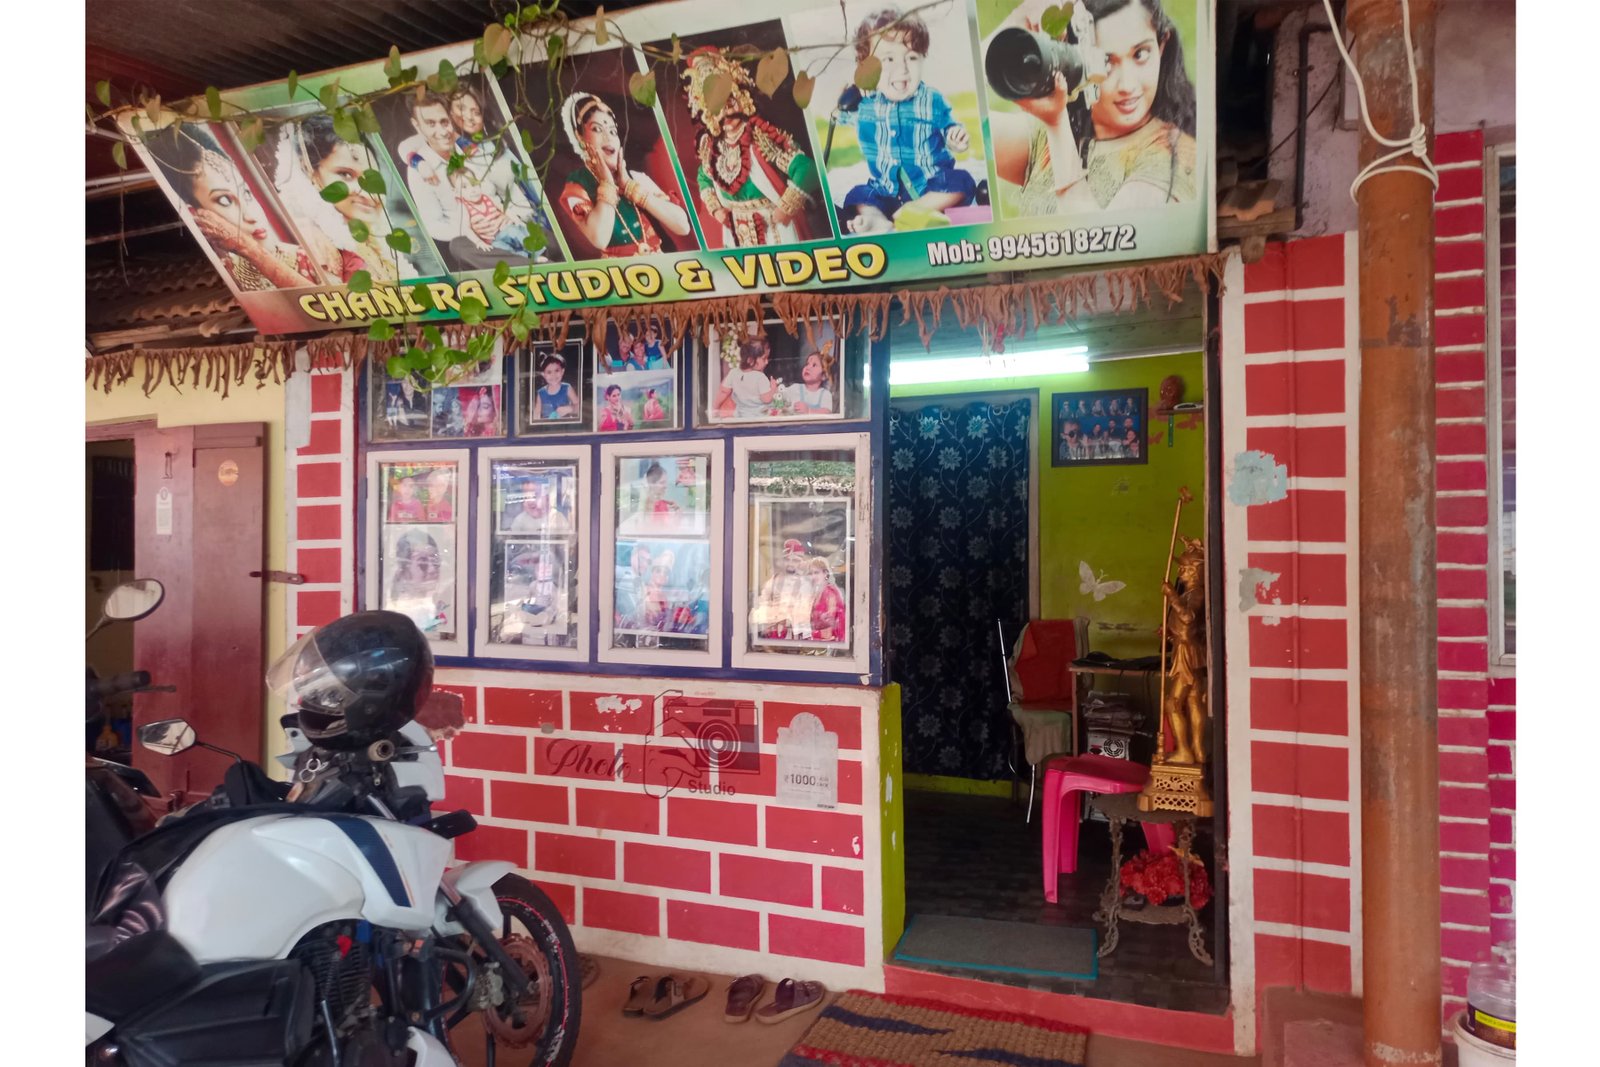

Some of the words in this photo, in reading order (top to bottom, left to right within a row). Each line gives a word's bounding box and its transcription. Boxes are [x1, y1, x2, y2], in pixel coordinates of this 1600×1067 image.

[926, 239, 983, 266] Mob:
[987, 224, 1136, 261] 9945618272
[498, 263, 664, 306] STUDIO
[674, 258, 715, 292] &
[721, 242, 888, 289] VIDEO
[687, 779, 737, 797] Studio
